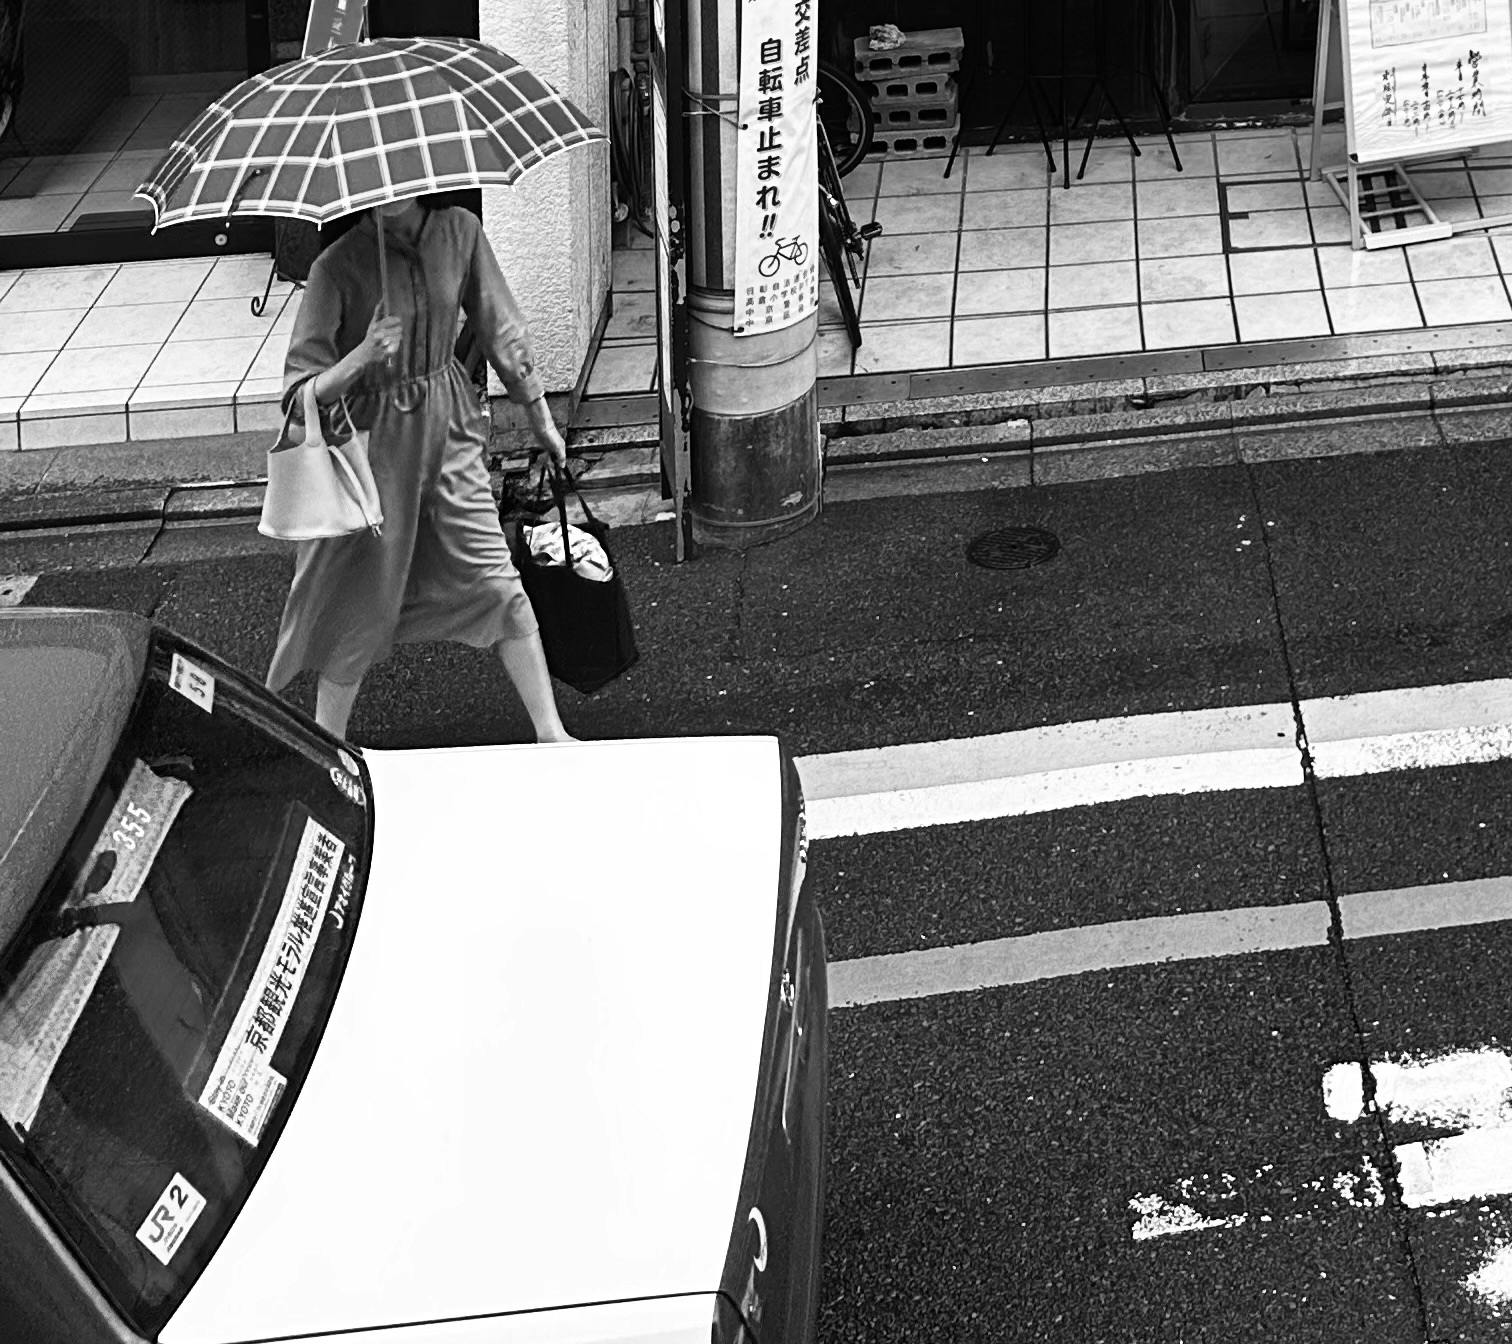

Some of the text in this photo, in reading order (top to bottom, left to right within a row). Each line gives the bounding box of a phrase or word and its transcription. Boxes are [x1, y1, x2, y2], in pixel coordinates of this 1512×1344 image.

[112, 800, 152, 850] 355
[245, 831, 338, 1054] 京都観光モラル推進宣言事業者
[167, 1183, 190, 1208] 2
[147, 1204, 175, 1246] JR
